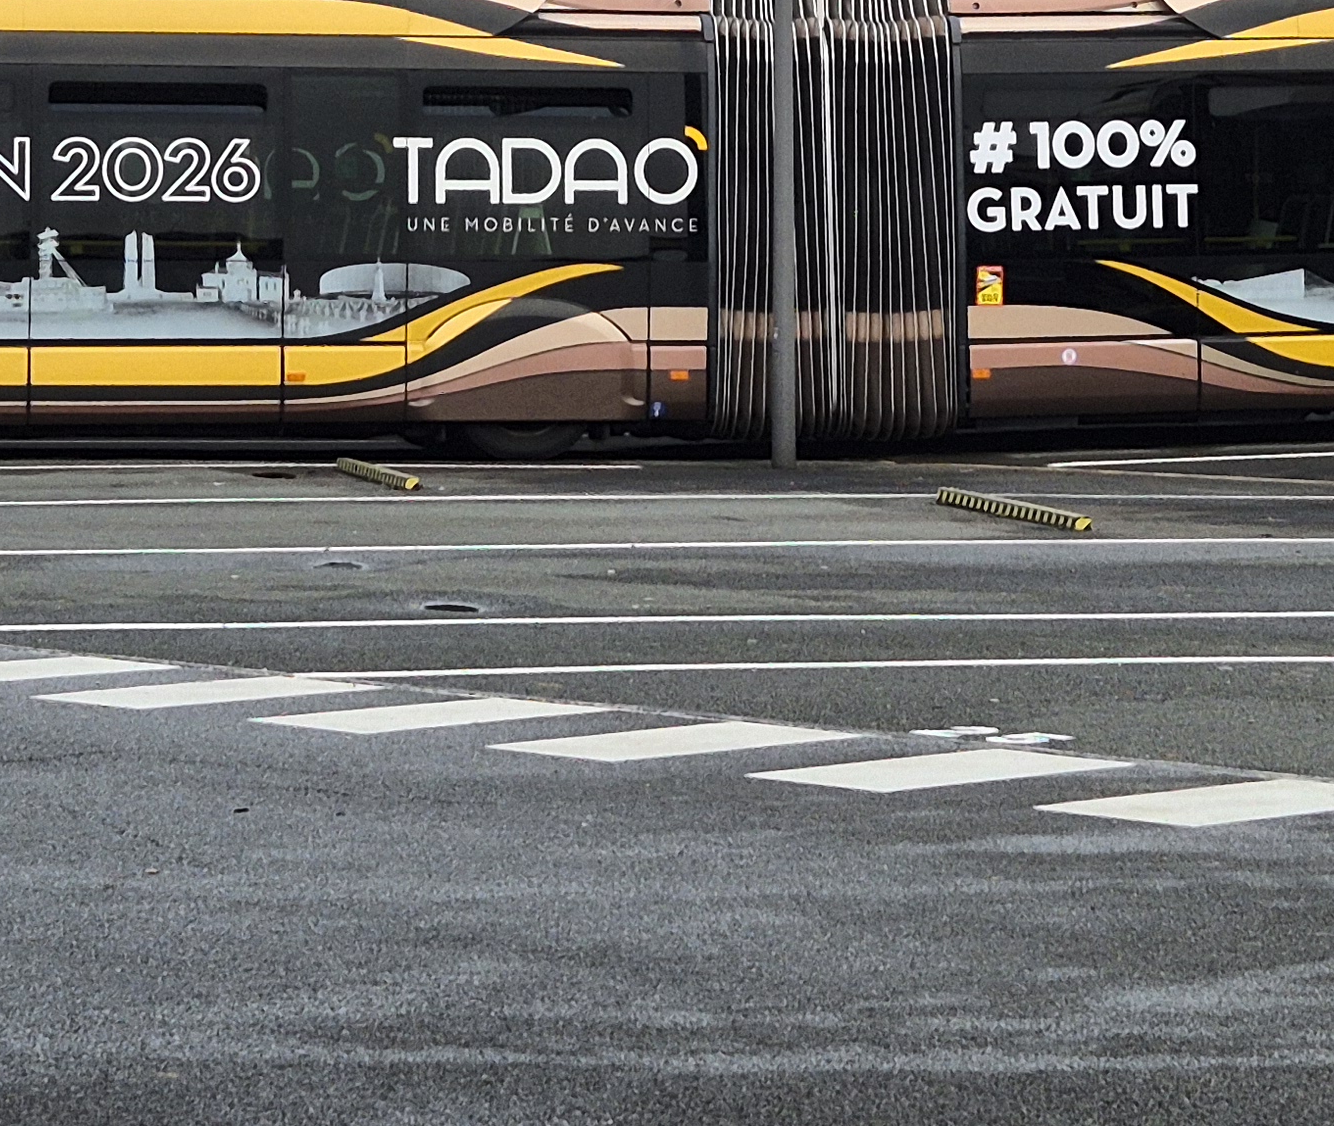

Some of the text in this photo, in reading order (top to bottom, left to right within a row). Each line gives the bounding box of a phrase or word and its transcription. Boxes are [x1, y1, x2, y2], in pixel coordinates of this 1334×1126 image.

[50, 136, 262, 203] 2026
[1029, 120, 1197, 170] 100%
[407, 213, 698, 233] UNE MOBILITÉ D'AVANCE
[966, 183, 1199, 233] GRATUIT
